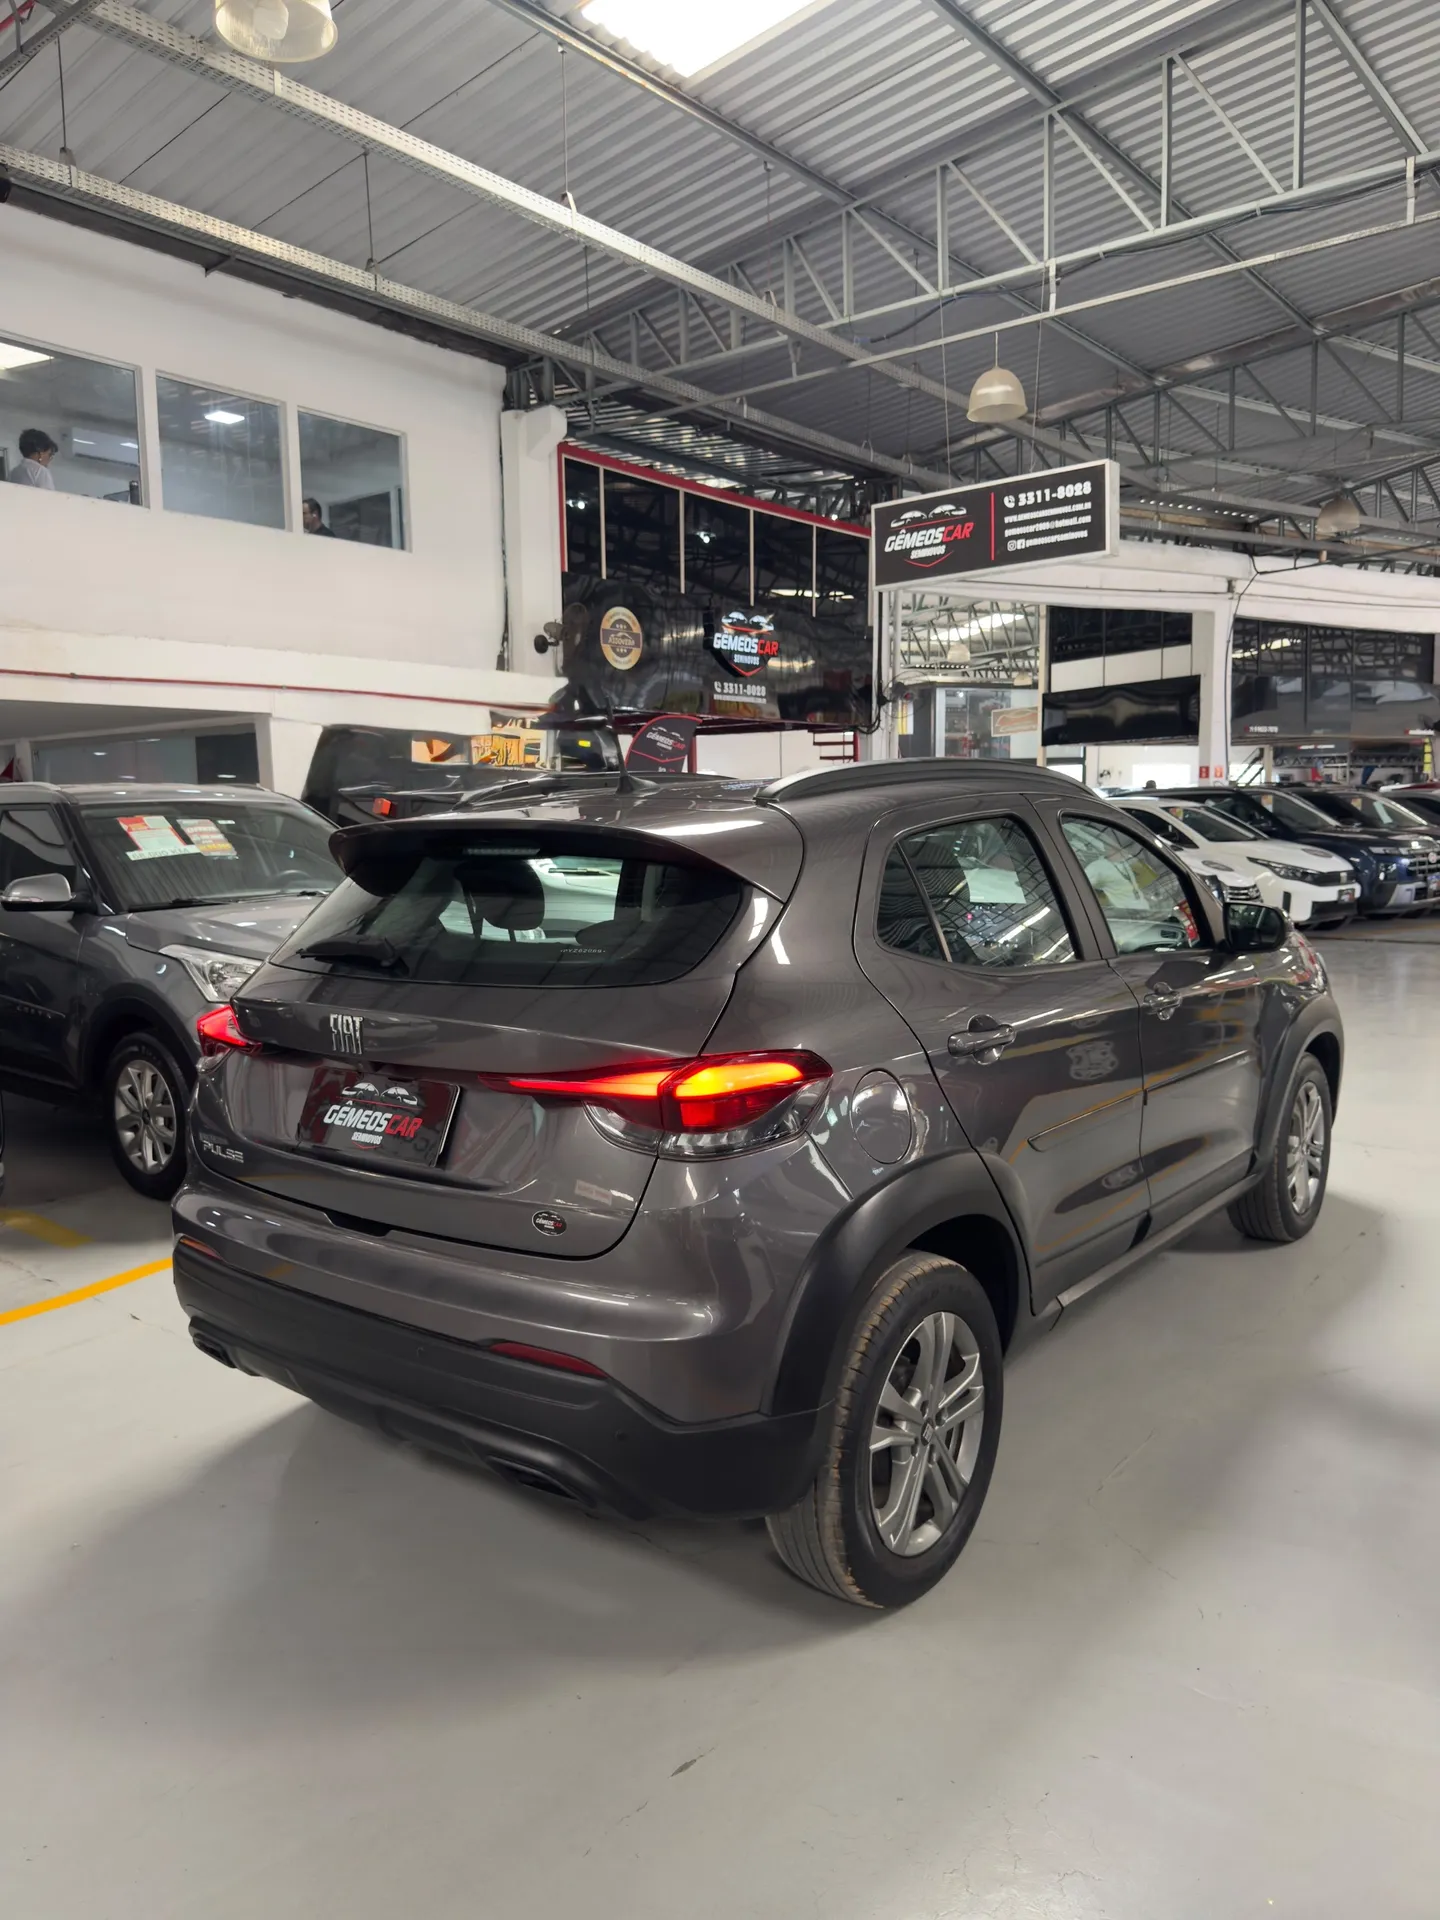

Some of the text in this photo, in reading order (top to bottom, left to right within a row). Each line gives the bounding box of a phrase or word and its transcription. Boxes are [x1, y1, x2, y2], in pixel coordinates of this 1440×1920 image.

[1018, 481, 1092, 506] 3311-8028
[910, 544, 946, 560] SEMINOVOS
[733, 654, 760, 665] SEMINOVOS
[723, 682, 766, 697] 3311-8028
[329, 1013, 364, 1055] FIAT
[323, 1100, 423, 1138] GÊMEOSCAR
[351, 1131, 383, 1145] SEMINOVOS
[202, 1140, 244, 1163] PULSE
